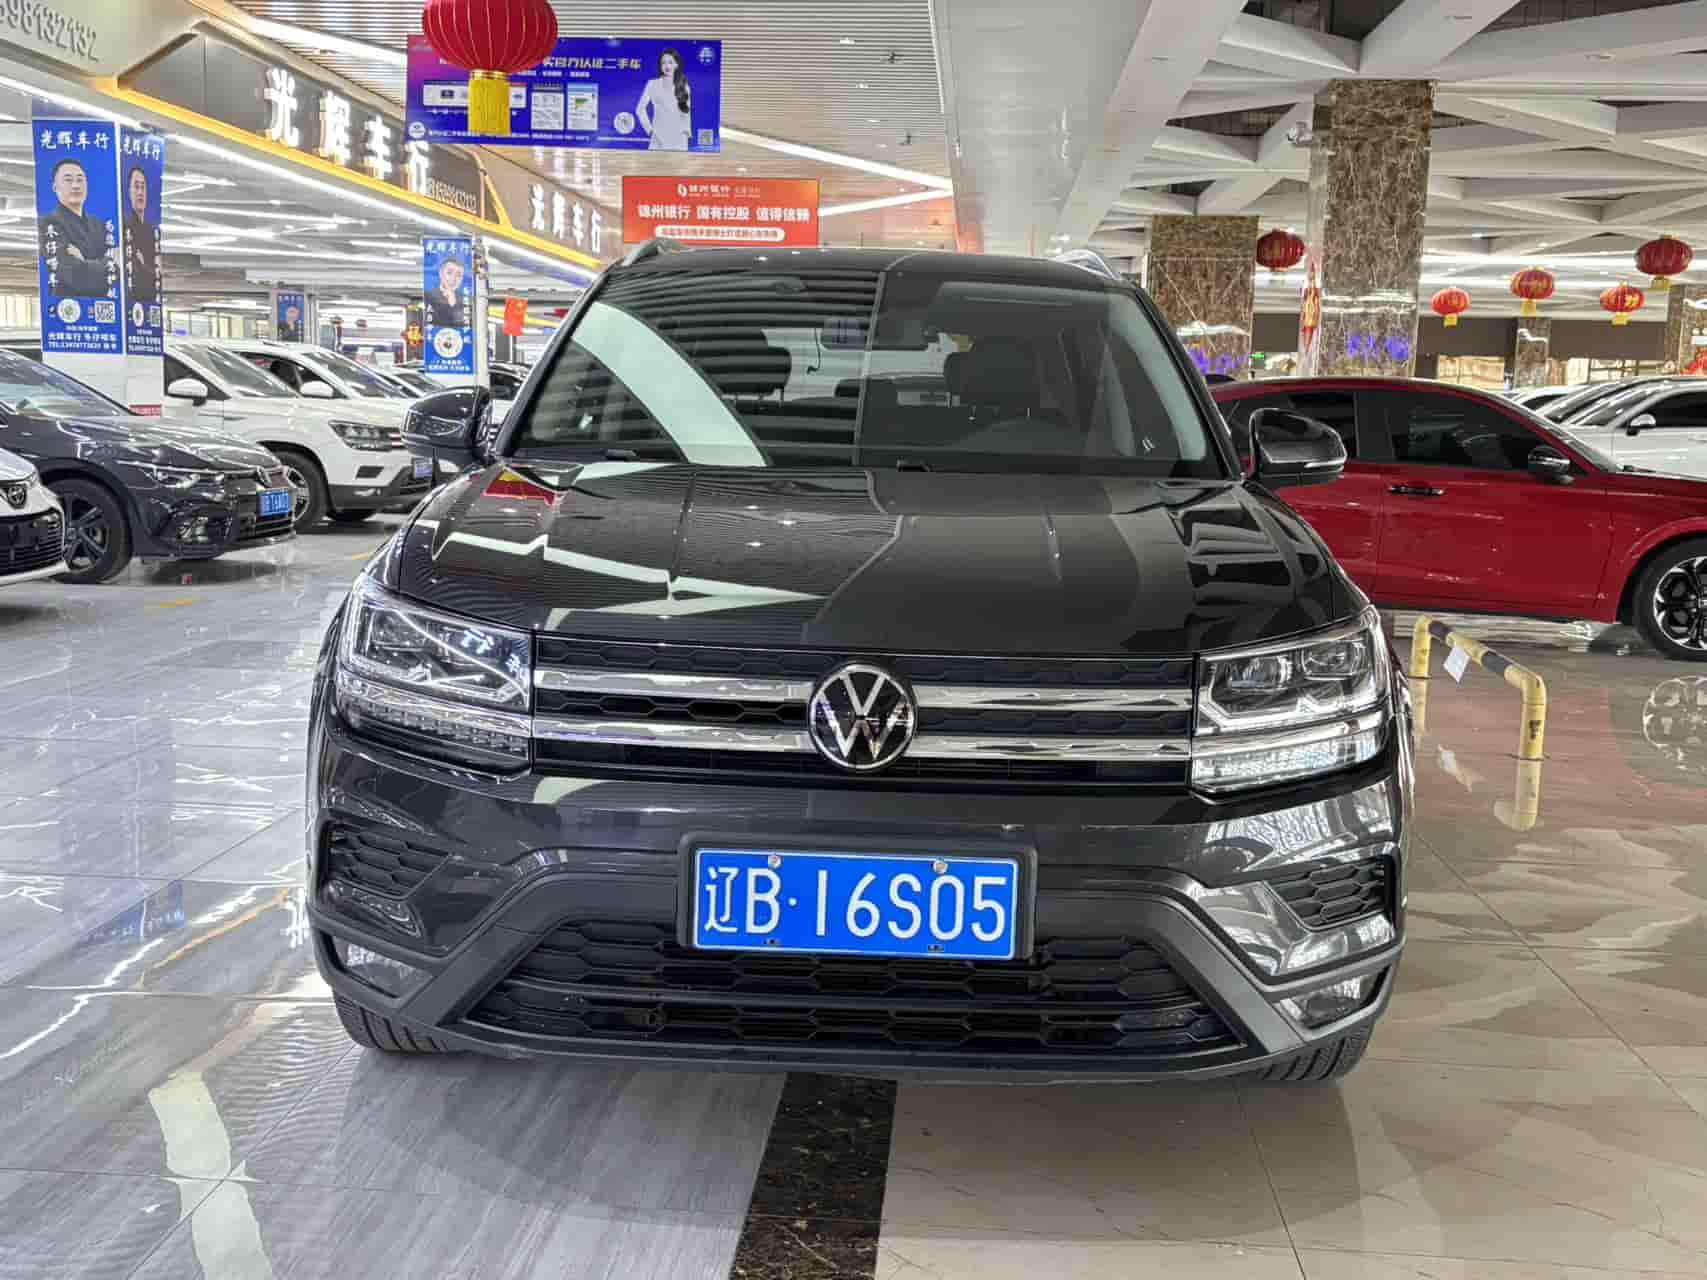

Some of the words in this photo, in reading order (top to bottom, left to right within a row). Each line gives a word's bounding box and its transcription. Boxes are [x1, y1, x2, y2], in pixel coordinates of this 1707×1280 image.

[40, 129, 111, 151] 光辉车行
[262, 67, 430, 194] 光辉车行
[704, 866, 1008, 942] 辽B·16S05
